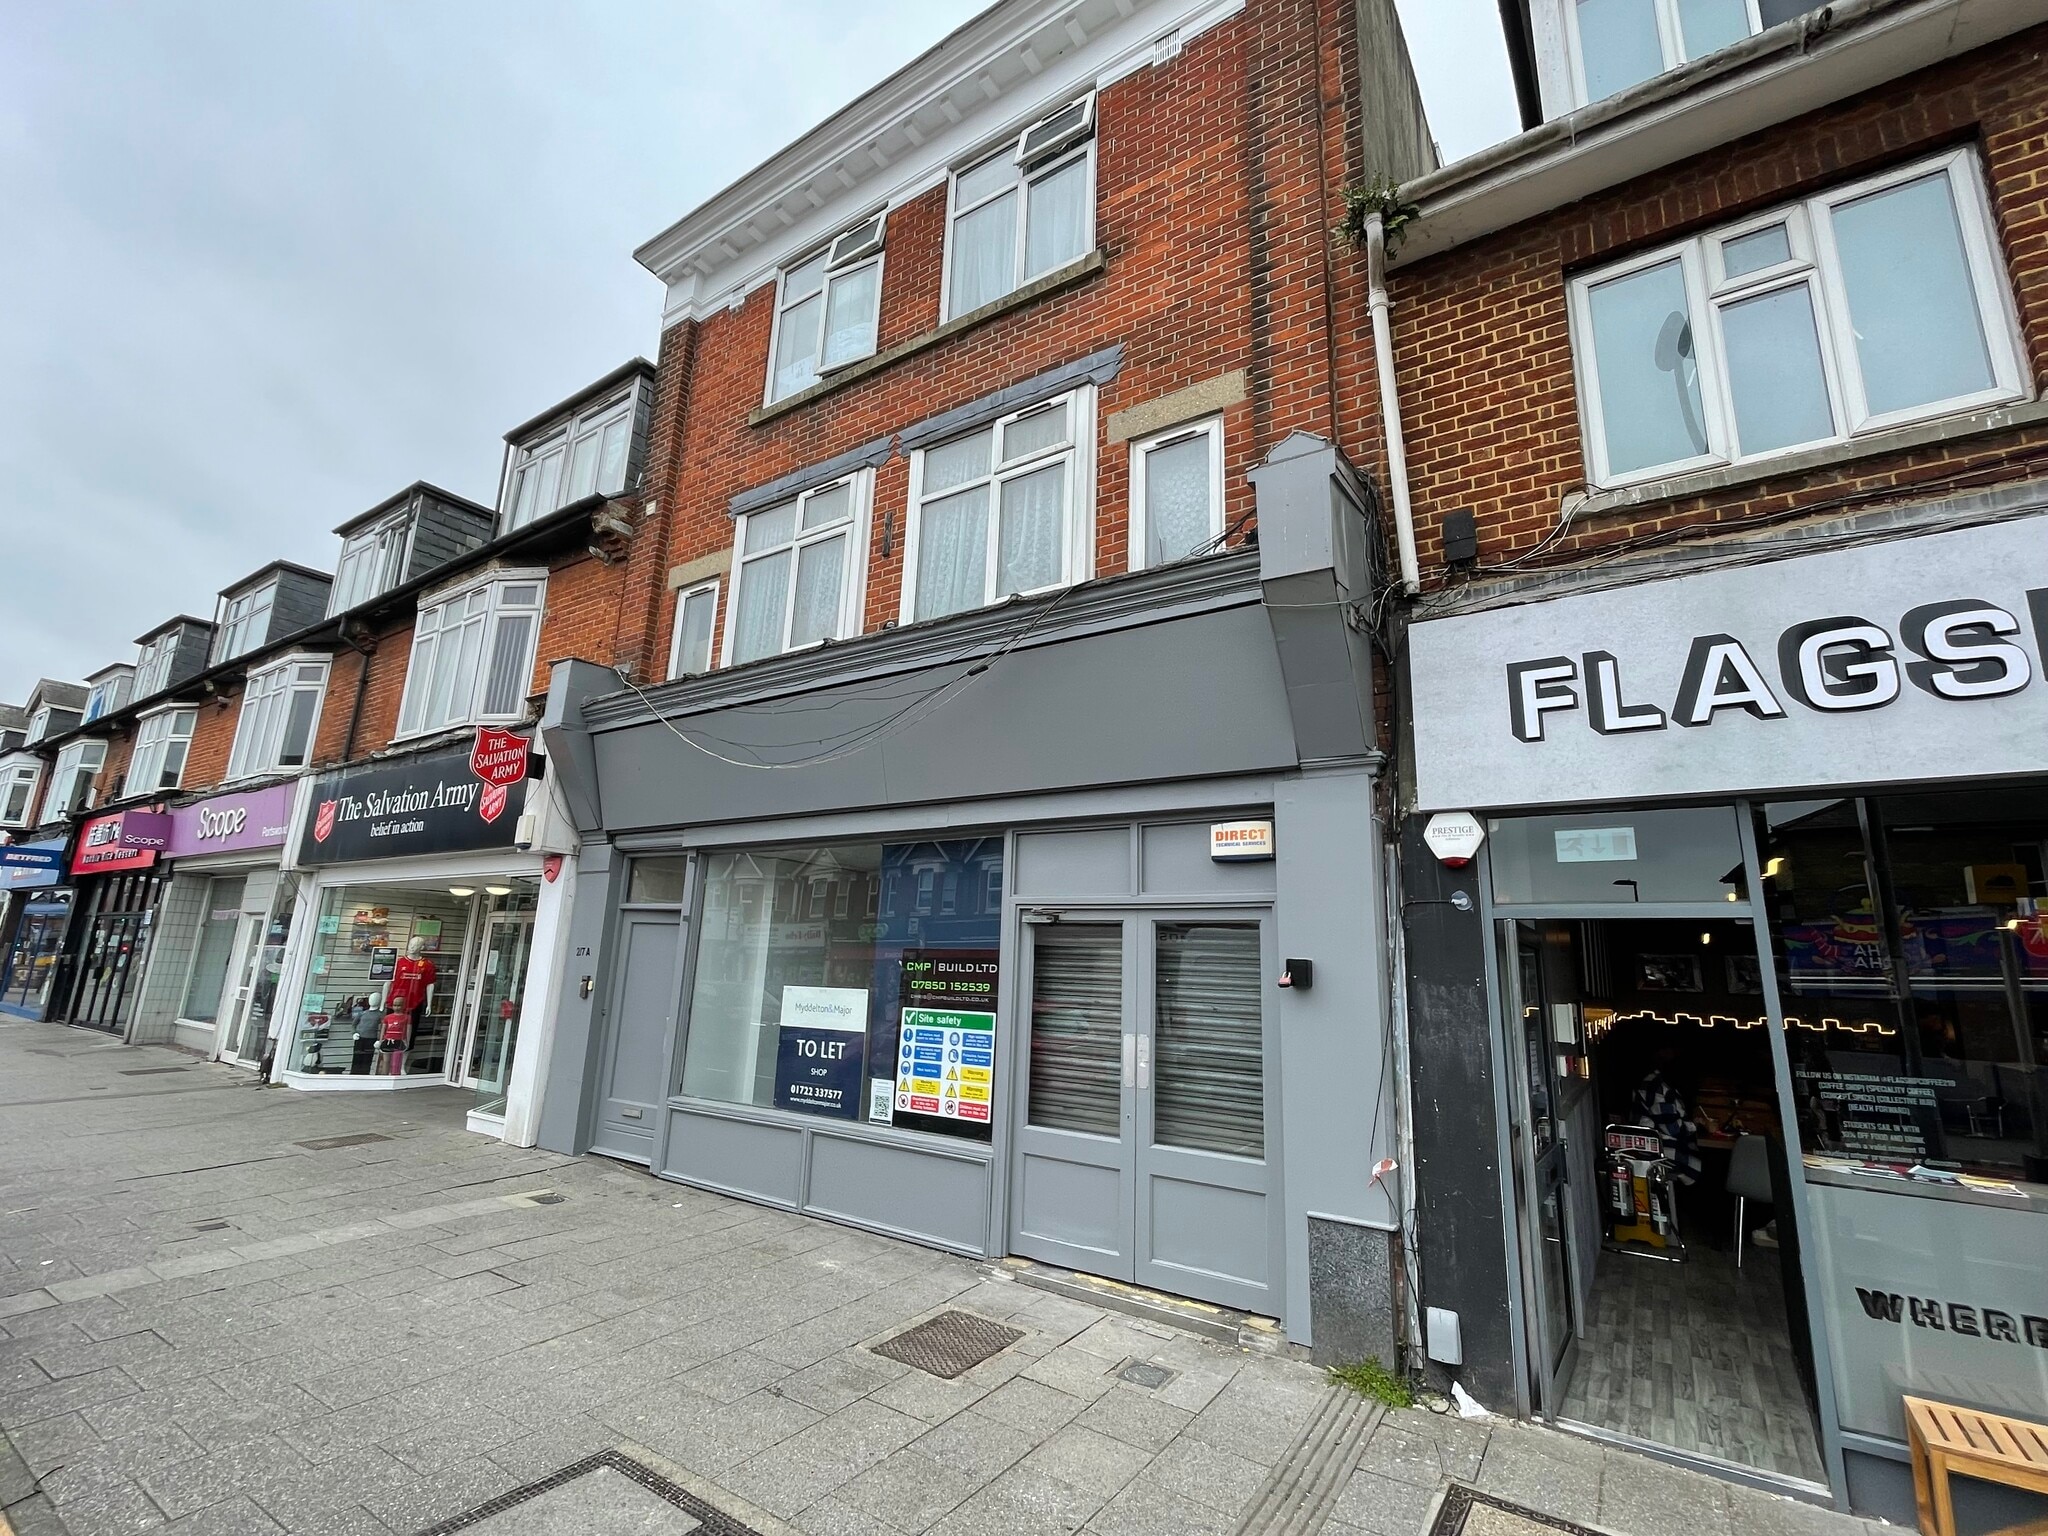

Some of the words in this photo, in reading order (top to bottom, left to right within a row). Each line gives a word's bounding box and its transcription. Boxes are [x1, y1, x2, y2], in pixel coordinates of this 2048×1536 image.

[1507, 586, 2048, 742] FLAGS
[488, 737, 507, 751] THE
[476, 744, 525, 769] SALVATION
[491, 761, 520, 780] ARMY
[338, 795, 362, 822] The
[363, 785, 429, 818] Salvation
[430, 780, 480, 812] Army
[197, 807, 247, 843] Scope
[370, 820, 394, 837] belief
[392, 820, 400, 834] in
[400, 817, 425, 833] action
[1432, 825, 1475, 835] PRESTIGE
[124, 834, 165, 846] Scope
[1215, 828, 1267, 842] DIRECT
[906, 962, 932, 971] CMP
[938, 963, 974, 973] BUILD
[975, 964, 998, 973] LTD
[911, 980, 946, 990] 07850
[950, 982, 991, 992] 152539
[795, 1003, 853, 1017] Myddelton&Major
[918, 1013, 934, 1023] Site
[936, 1015, 962, 1026] safety
[796, 1039, 817, 1057] TO
[820, 1041, 846, 1060] LET
[810, 1067, 828, 1077] SHOP
[1795, 1070, 1821, 1078] FOLLOW
[1843, 1073, 1880, 1081] INSTAGRAM
[790, 1084, 813, 1097] 01722
[814, 1087, 843, 1100] 337577
[1843, 1120, 1876, 1130] STUDENTS
[1901, 1125, 1920, 1133] WITH
[1870, 1132, 1888, 1141] FOOD
[1890, 1134, 1903, 1142] AND
